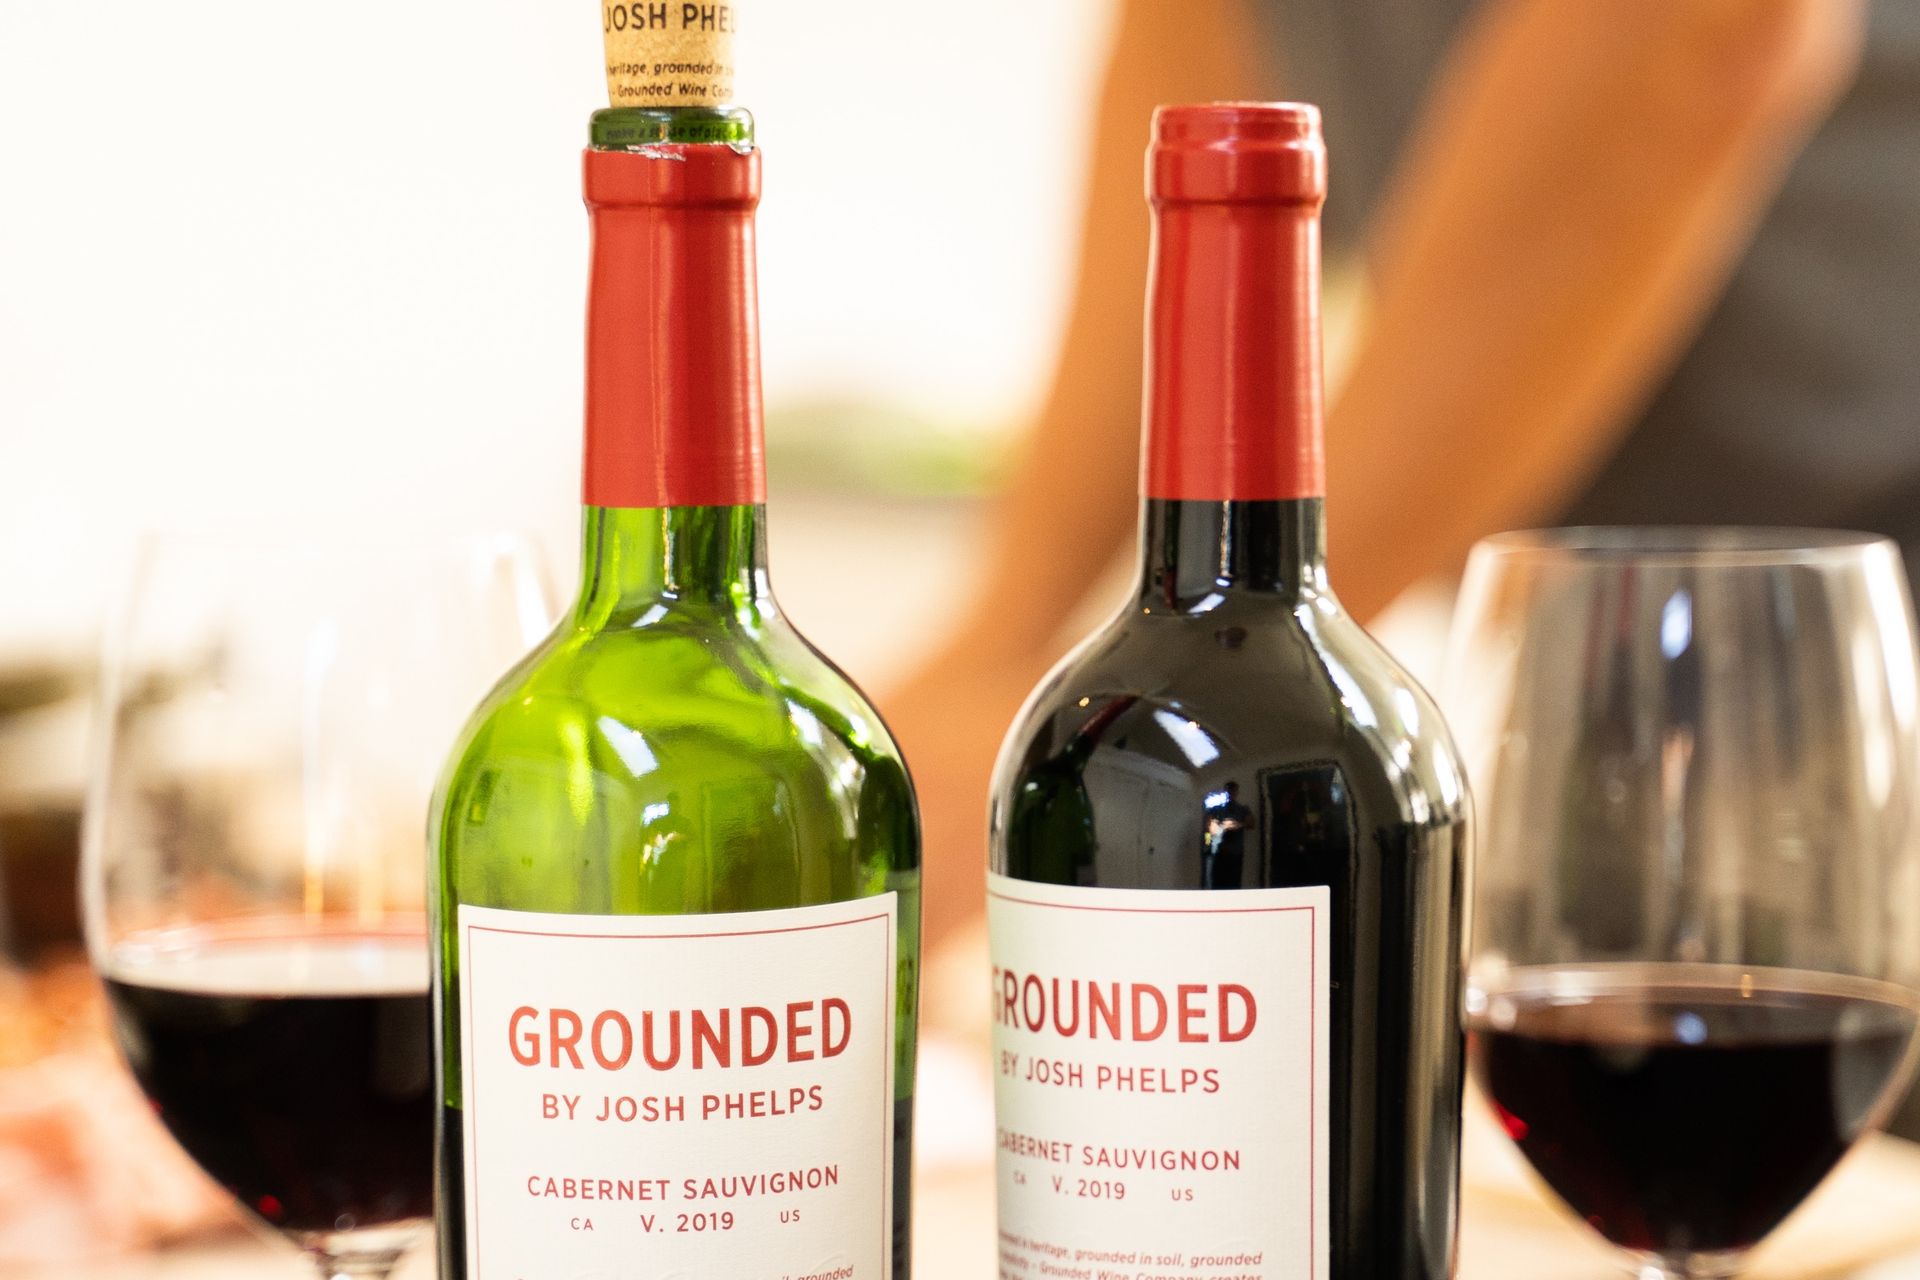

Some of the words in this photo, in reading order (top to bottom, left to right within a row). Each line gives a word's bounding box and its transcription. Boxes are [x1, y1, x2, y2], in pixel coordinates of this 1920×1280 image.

[605, 3, 667, 33] JOSH
[654, 61, 714, 76] grounded
[618, 82, 672, 97] Grounded
[678, 83, 707, 97] Wine
[507, 996, 853, 1072] GROUNDED
[1025, 1057, 1084, 1089] JOSH
[1097, 1065, 1222, 1095] PHELPS
[542, 1094, 582, 1121] BY
[595, 1095, 686, 1123] JOSH
[702, 1085, 825, 1122] PHELPS
[1082, 1145, 1242, 1172] SAUVIGNON
[527, 1174, 671, 1202] CABERNET
[683, 1164, 840, 1202] SAUVIGNON
[1052, 1176, 1070, 1196] V.
[1077, 1178, 1127, 1201] 2019
[1171, 1188, 1195, 1203] US
[570, 1217, 595, 1232] CA
[640, 1214, 666, 1234] V.
[677, 1211, 736, 1234] 2019
[779, 1209, 802, 1226] US
[1075, 1248, 1137, 1265] grounded
[1140, 1254, 1153, 1266] in
[1155, 1252, 1186, 1268] soil,
[1190, 1251, 1264, 1269] grounded
